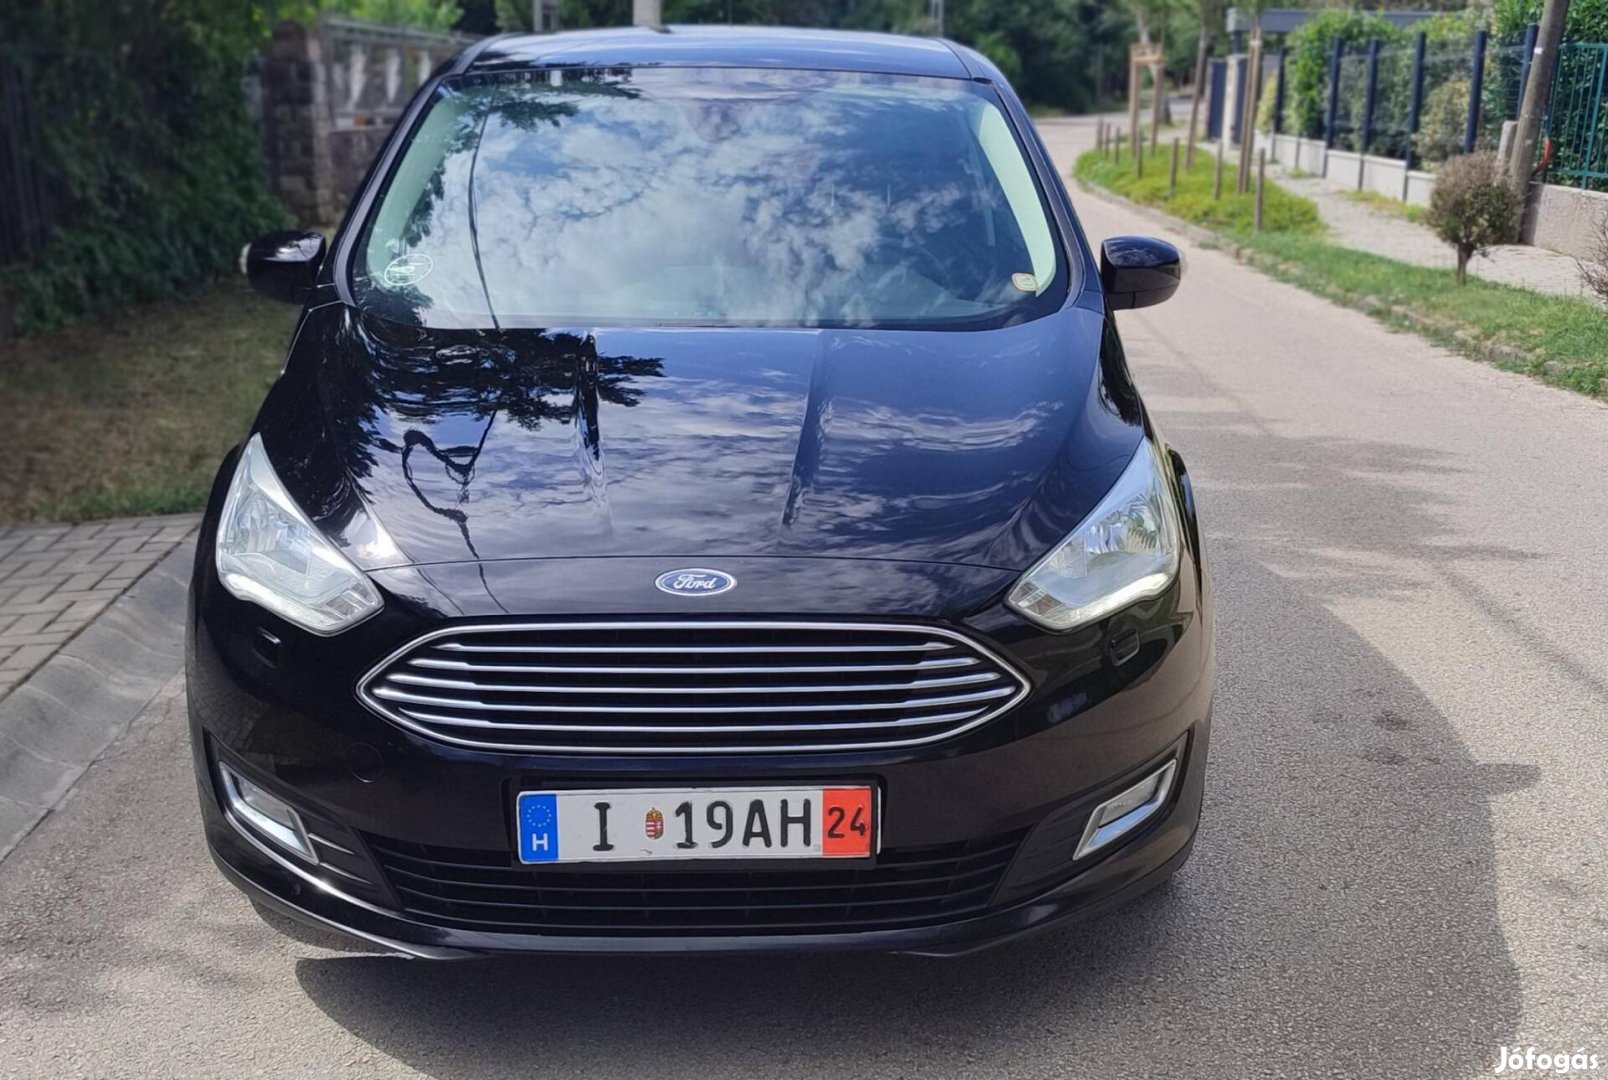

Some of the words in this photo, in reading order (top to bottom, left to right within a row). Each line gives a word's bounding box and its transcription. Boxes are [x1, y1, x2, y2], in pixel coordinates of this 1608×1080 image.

[673, 573, 717, 589] Ford
[532, 832, 549, 852] H
[593, 801, 615, 852] I
[674, 798, 812, 849] 19AH
[827, 805, 868, 839] 24
